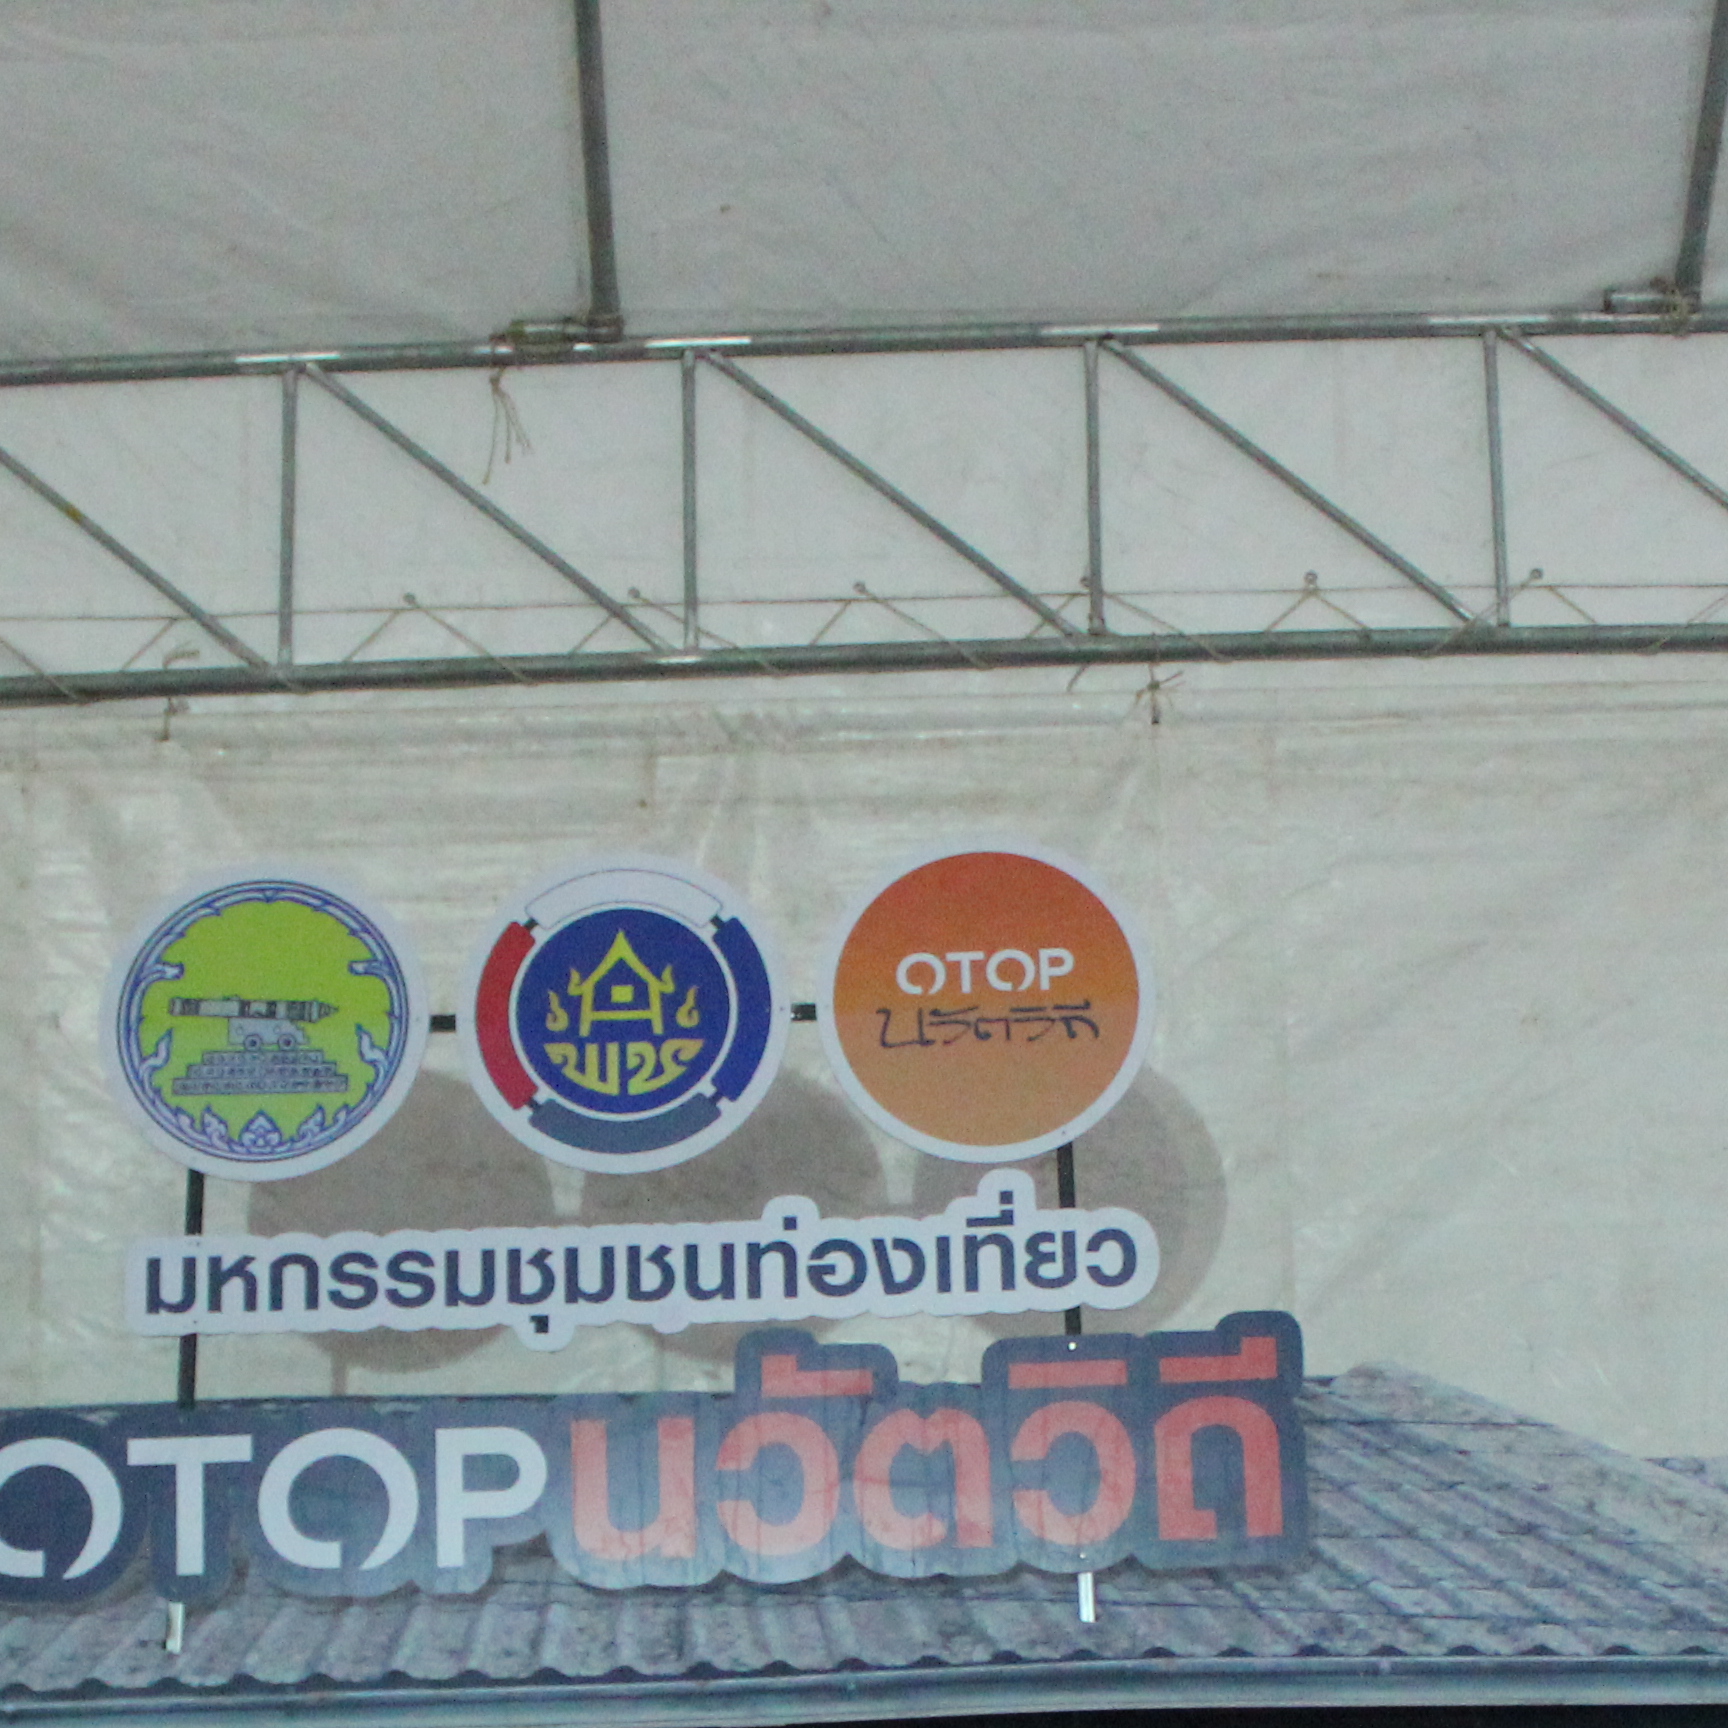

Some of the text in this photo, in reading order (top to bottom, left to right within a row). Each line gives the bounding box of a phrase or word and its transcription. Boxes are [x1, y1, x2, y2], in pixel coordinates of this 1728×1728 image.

[895, 947, 1075, 995] OTOP
[144, 1189, 1140, 1335] มหกรรมชุมชนท่องเที่ยว
[569, 1336, 1284, 1559] นวัตวิถี
